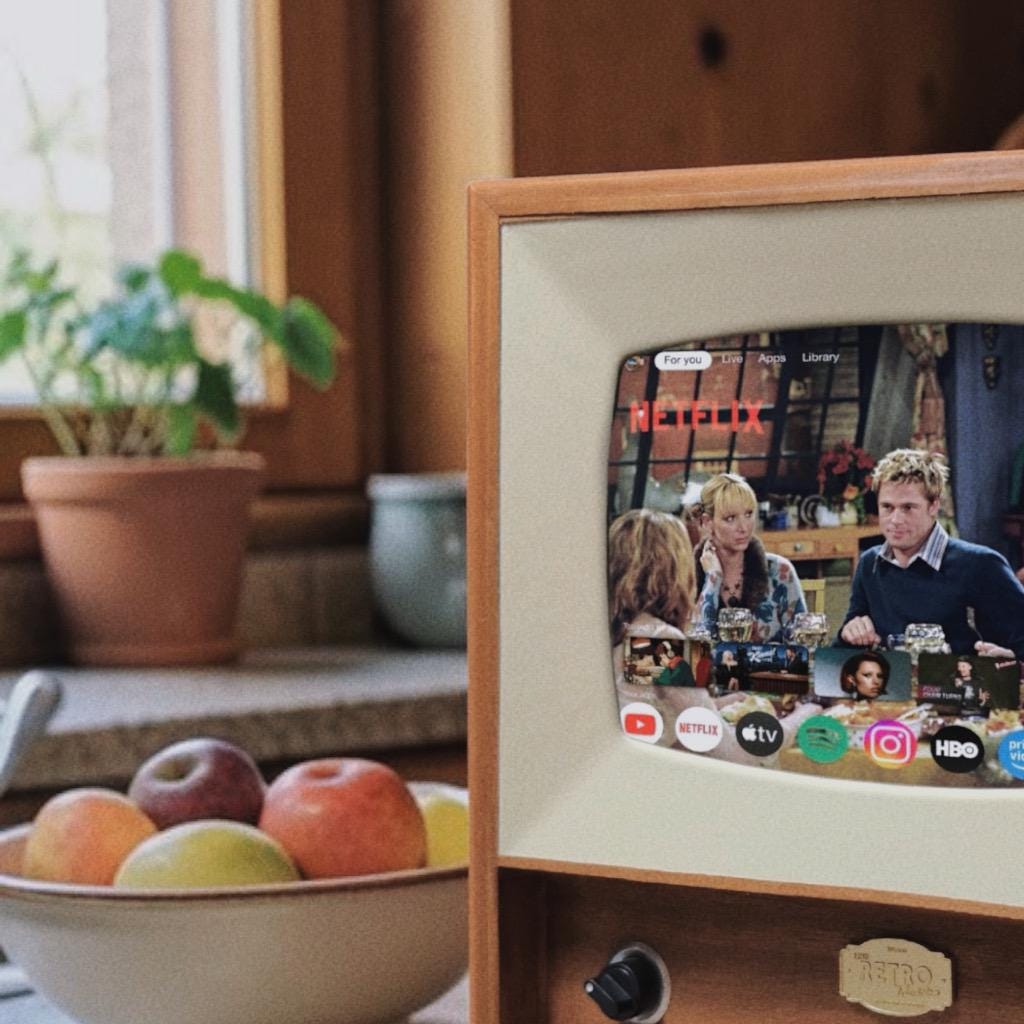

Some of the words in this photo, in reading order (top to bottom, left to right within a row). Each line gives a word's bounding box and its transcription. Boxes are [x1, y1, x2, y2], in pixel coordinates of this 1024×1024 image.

[664, 354, 681, 365] For
[684, 356, 702, 367] you
[721, 353, 744, 364] Live
[757, 352, 787, 365] Apps
[802, 352, 840, 364] Library
[629, 398, 765, 434] NETFLIX
[678, 722, 719, 737] NETFLIX
[758, 729, 778, 743] tv
[935, 739, 979, 759] HBO
[860, 960, 933, 986] RETRO
